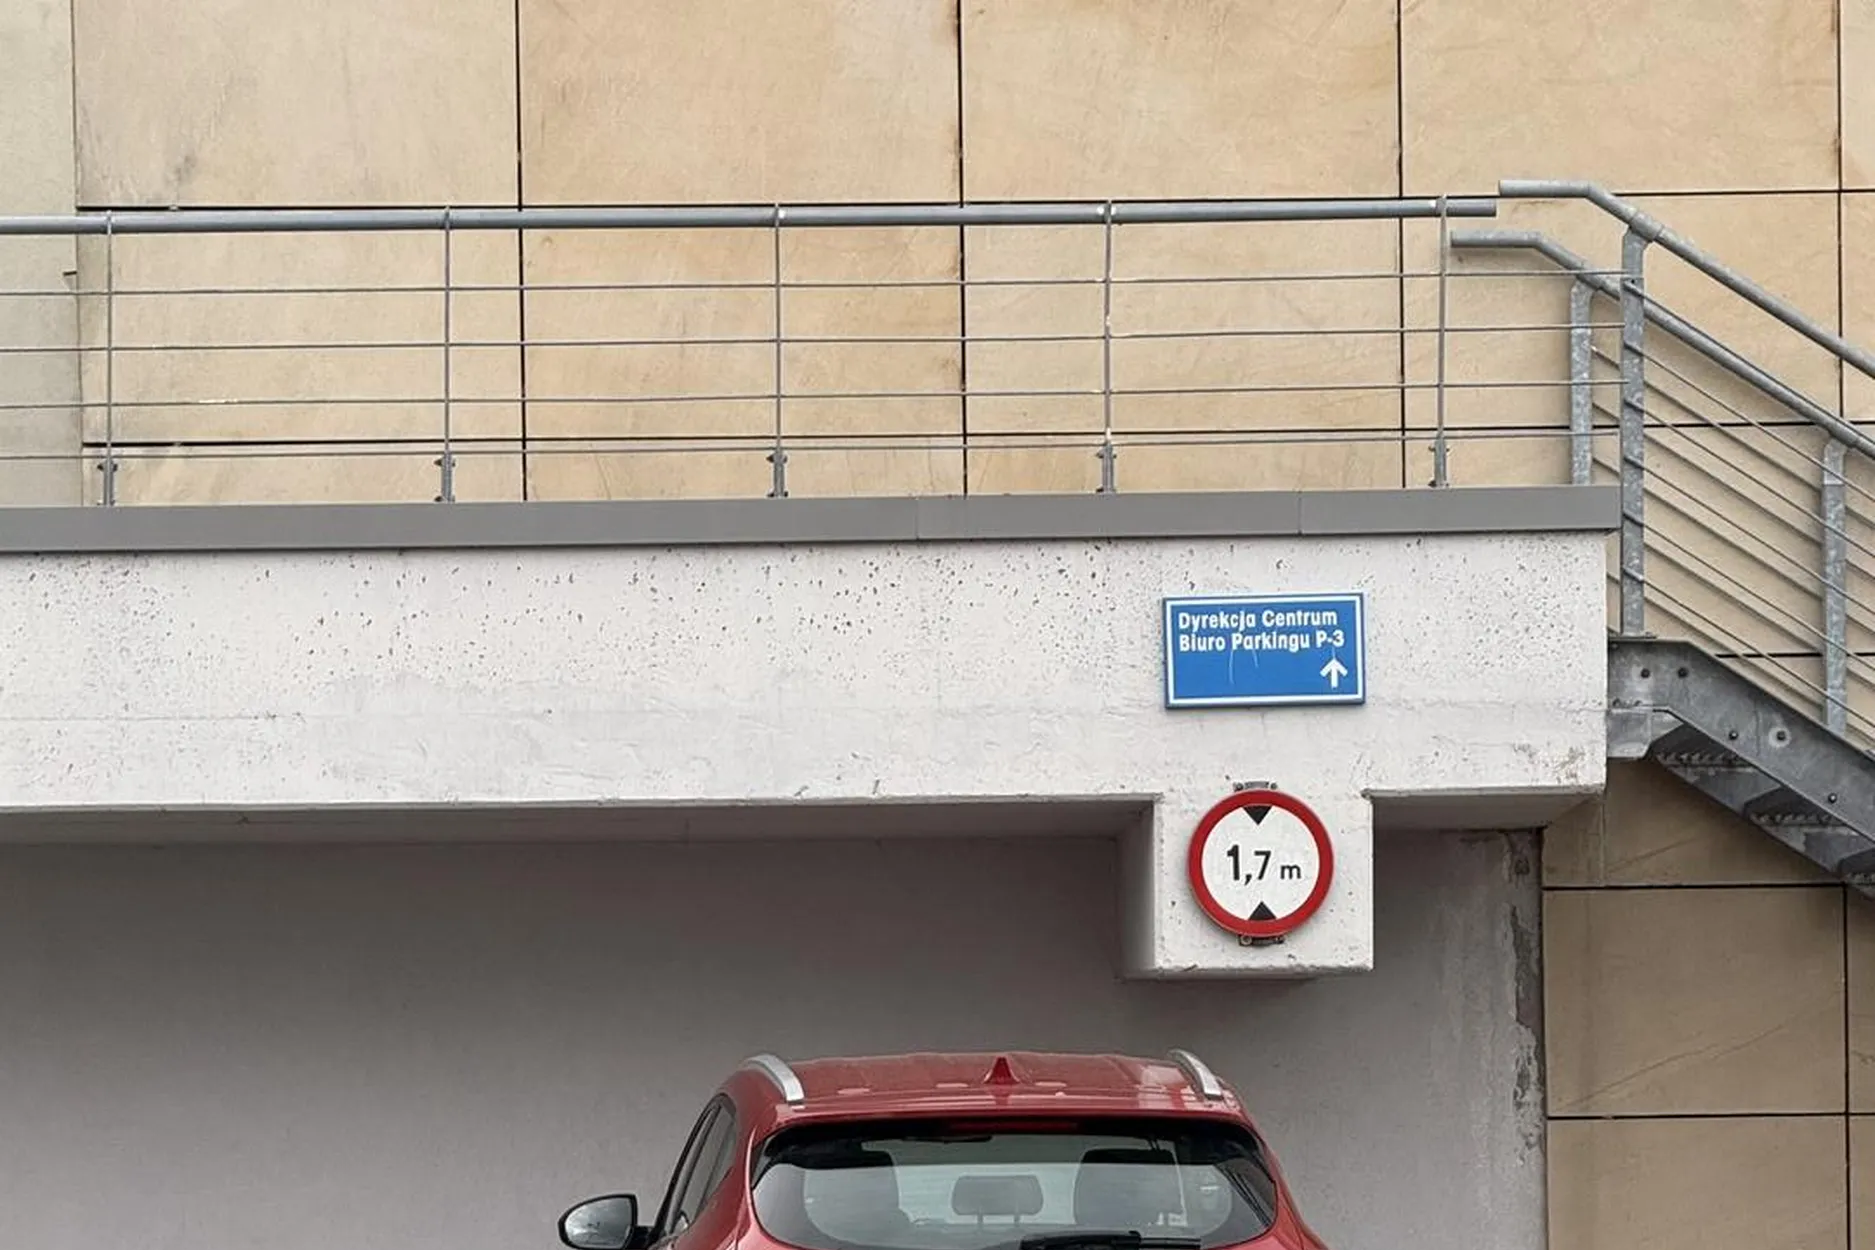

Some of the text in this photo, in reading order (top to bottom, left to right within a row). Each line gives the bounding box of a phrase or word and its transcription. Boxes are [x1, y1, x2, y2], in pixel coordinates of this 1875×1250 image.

[1178, 609, 1338, 632] Dyrekcja Centrum
[1179, 630, 1345, 653] Biuro Parkingu P-3
[1226, 843, 1302, 886] 1,7 m
